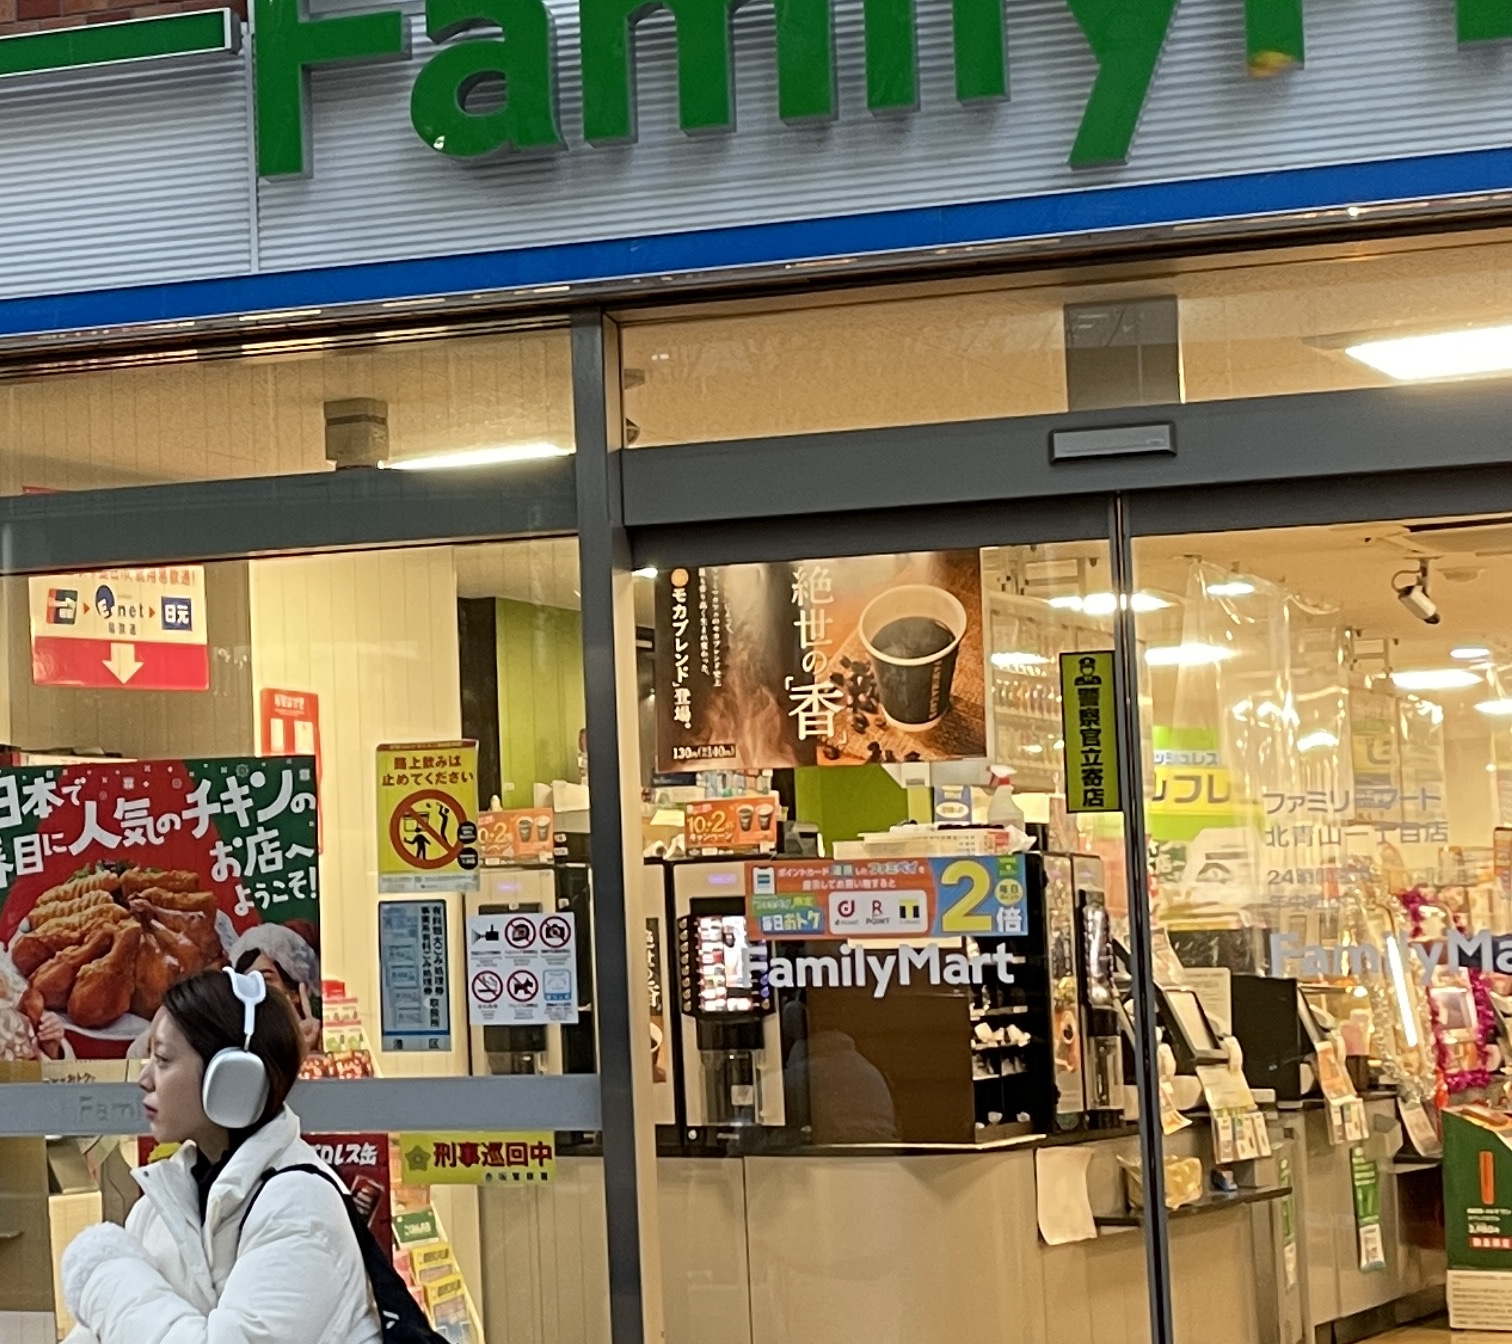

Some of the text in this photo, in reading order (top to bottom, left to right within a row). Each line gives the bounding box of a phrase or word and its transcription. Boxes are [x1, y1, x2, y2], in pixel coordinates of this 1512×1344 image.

[1076, 687, 1106, 808] 警察官立寄店
[381, 770, 475, 787] 止めてください
[208, 825, 316, 884] お店へ
[940, 859, 993, 933] 2
[996, 906, 1023, 933] 倍
[742, 942, 1015, 1000] FamilyMart
[432, 1140, 553, 1168] 刑事巡回中
